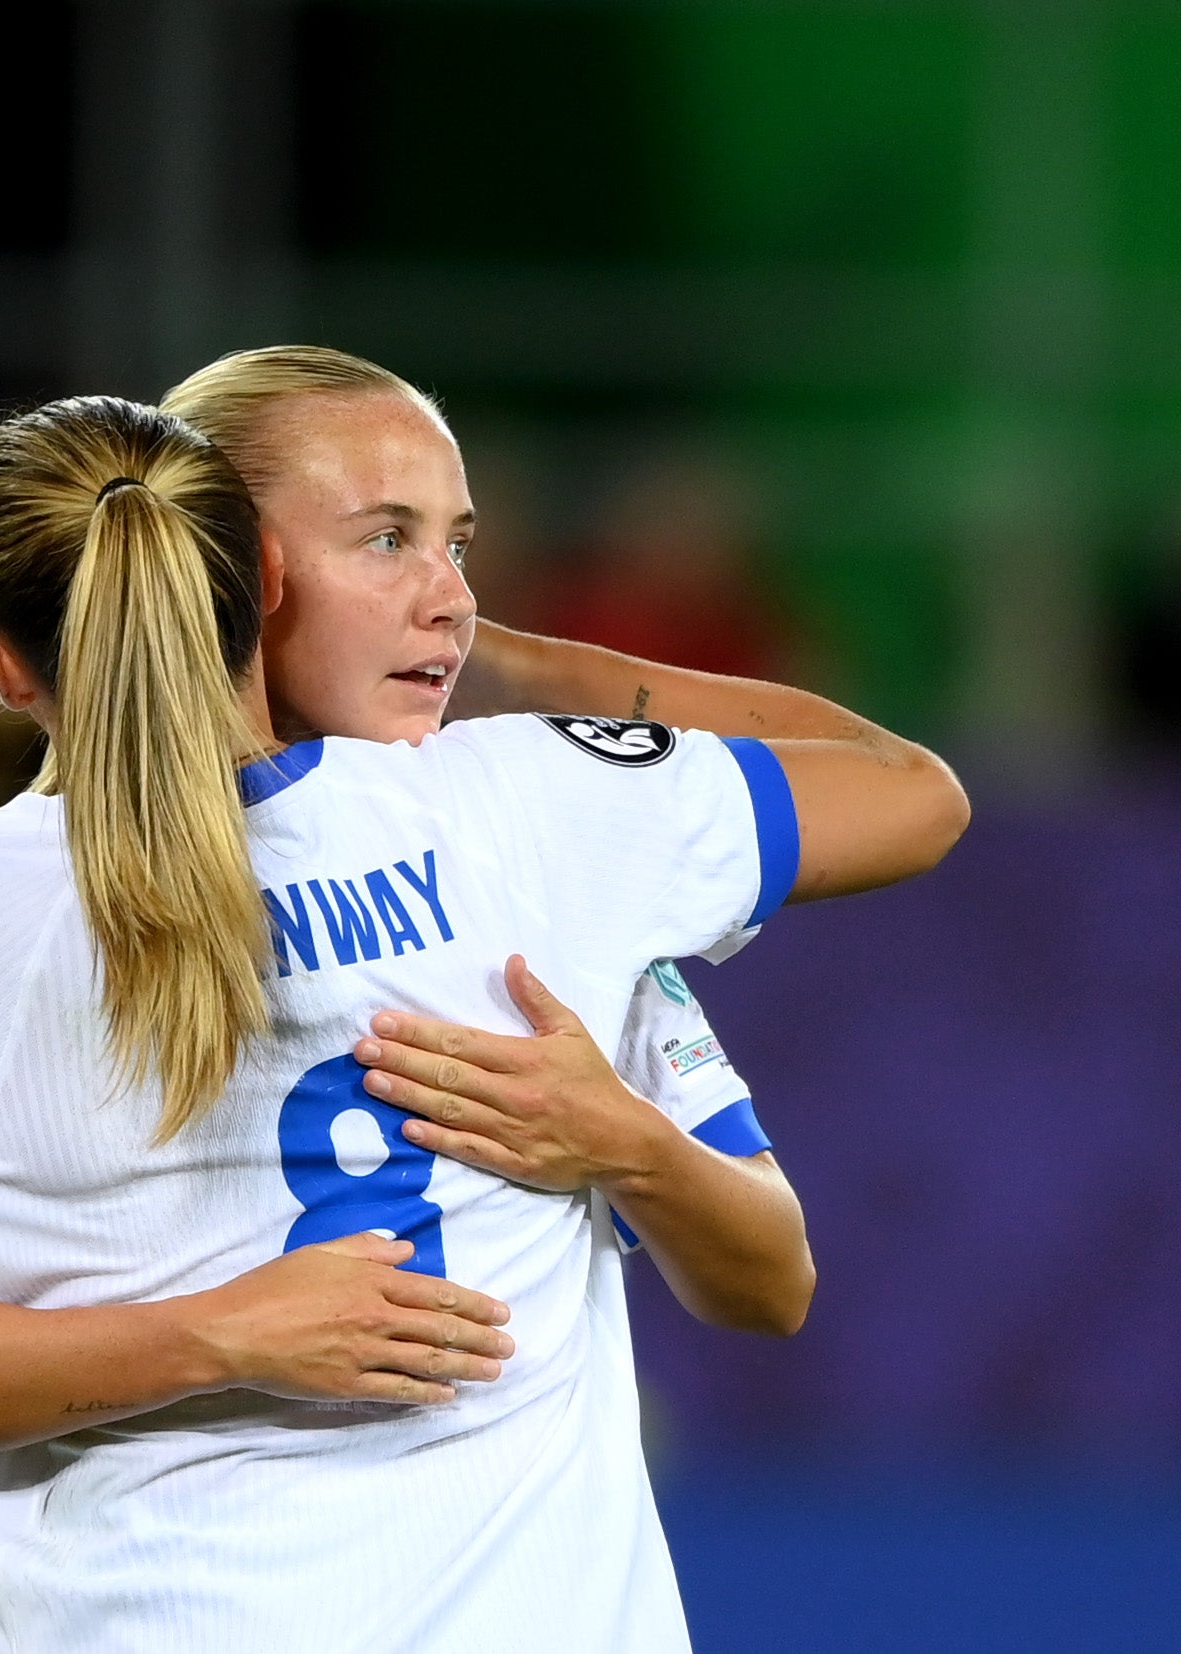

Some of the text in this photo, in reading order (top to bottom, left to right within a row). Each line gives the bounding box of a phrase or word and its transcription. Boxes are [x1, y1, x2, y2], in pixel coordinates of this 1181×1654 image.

[260, 849, 454, 979] NWAY
[661, 1038, 680, 1054] UEFA
[278, 1053, 446, 1279] 8
